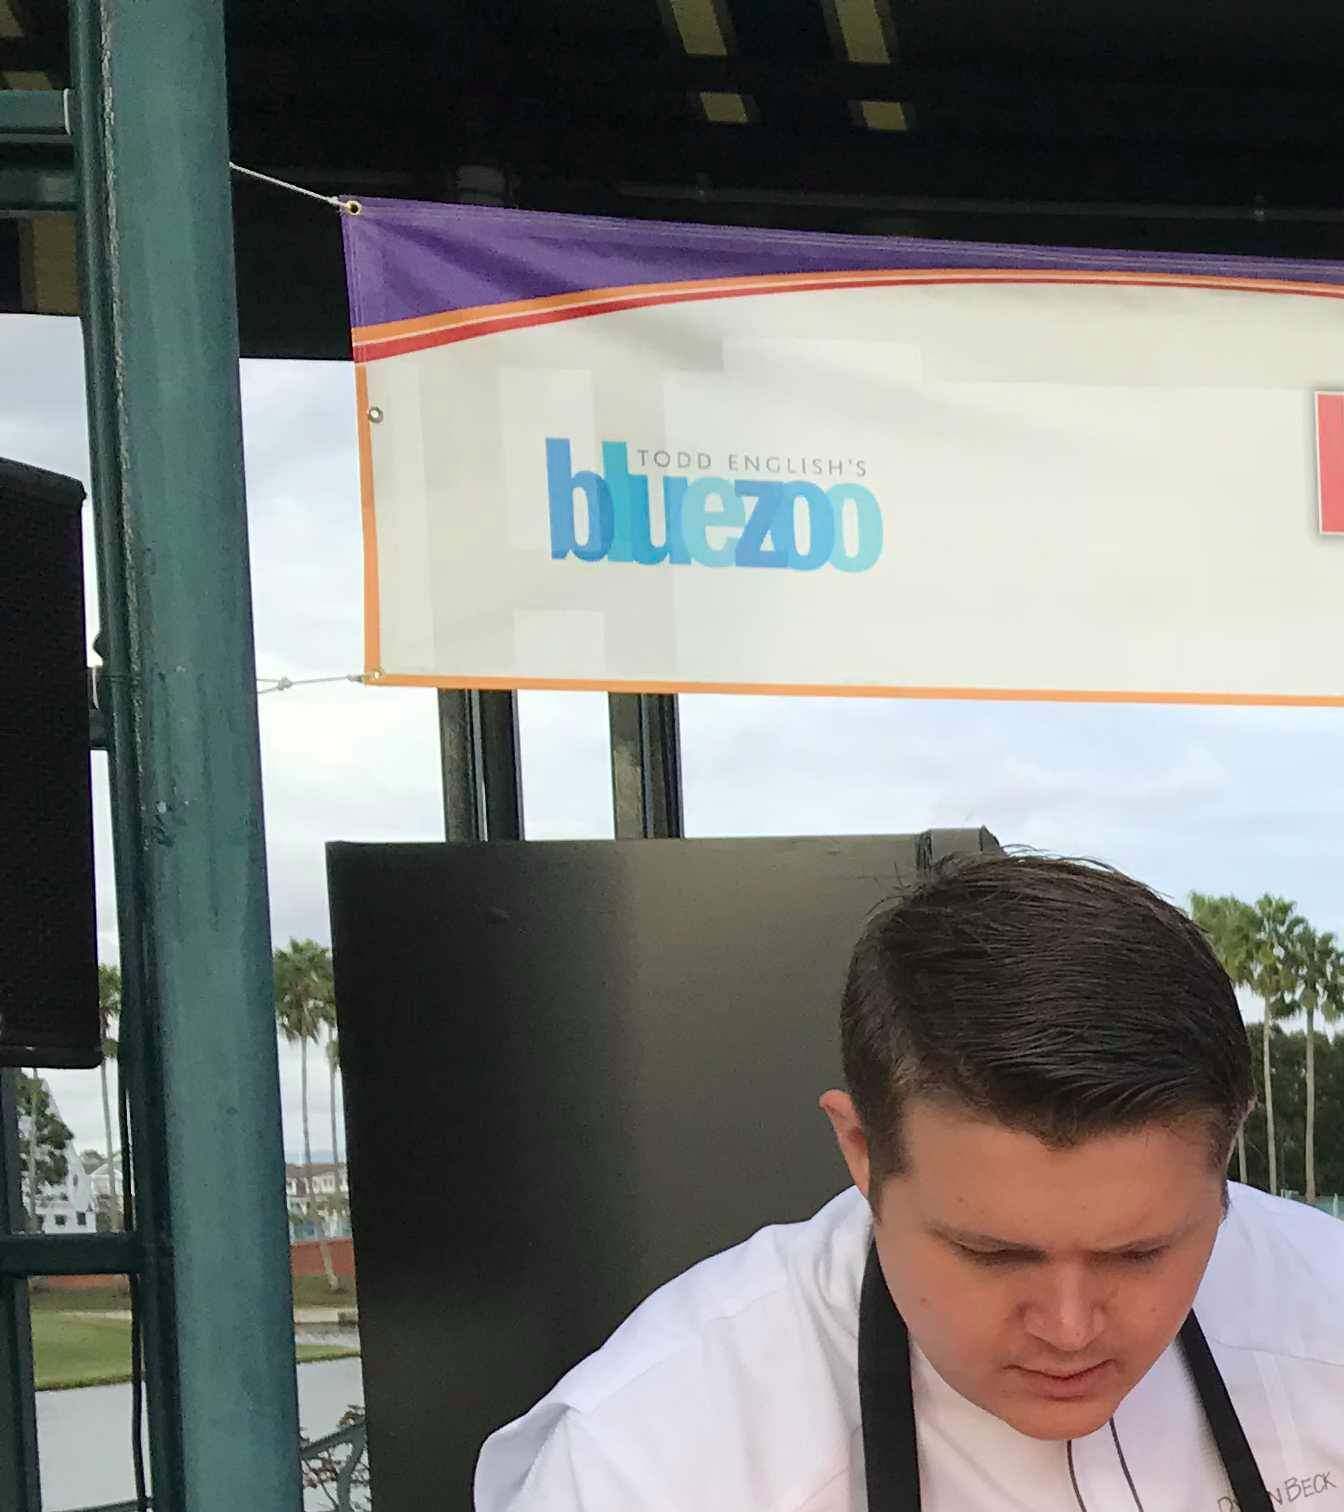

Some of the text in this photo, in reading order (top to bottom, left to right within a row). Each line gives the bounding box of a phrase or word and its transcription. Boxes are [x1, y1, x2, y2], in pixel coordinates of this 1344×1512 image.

[637, 449, 868, 478] TODD ENGLISH'S
[544, 437, 884, 573] bluezoo
[1284, 1472, 1337, 1503] BECK
